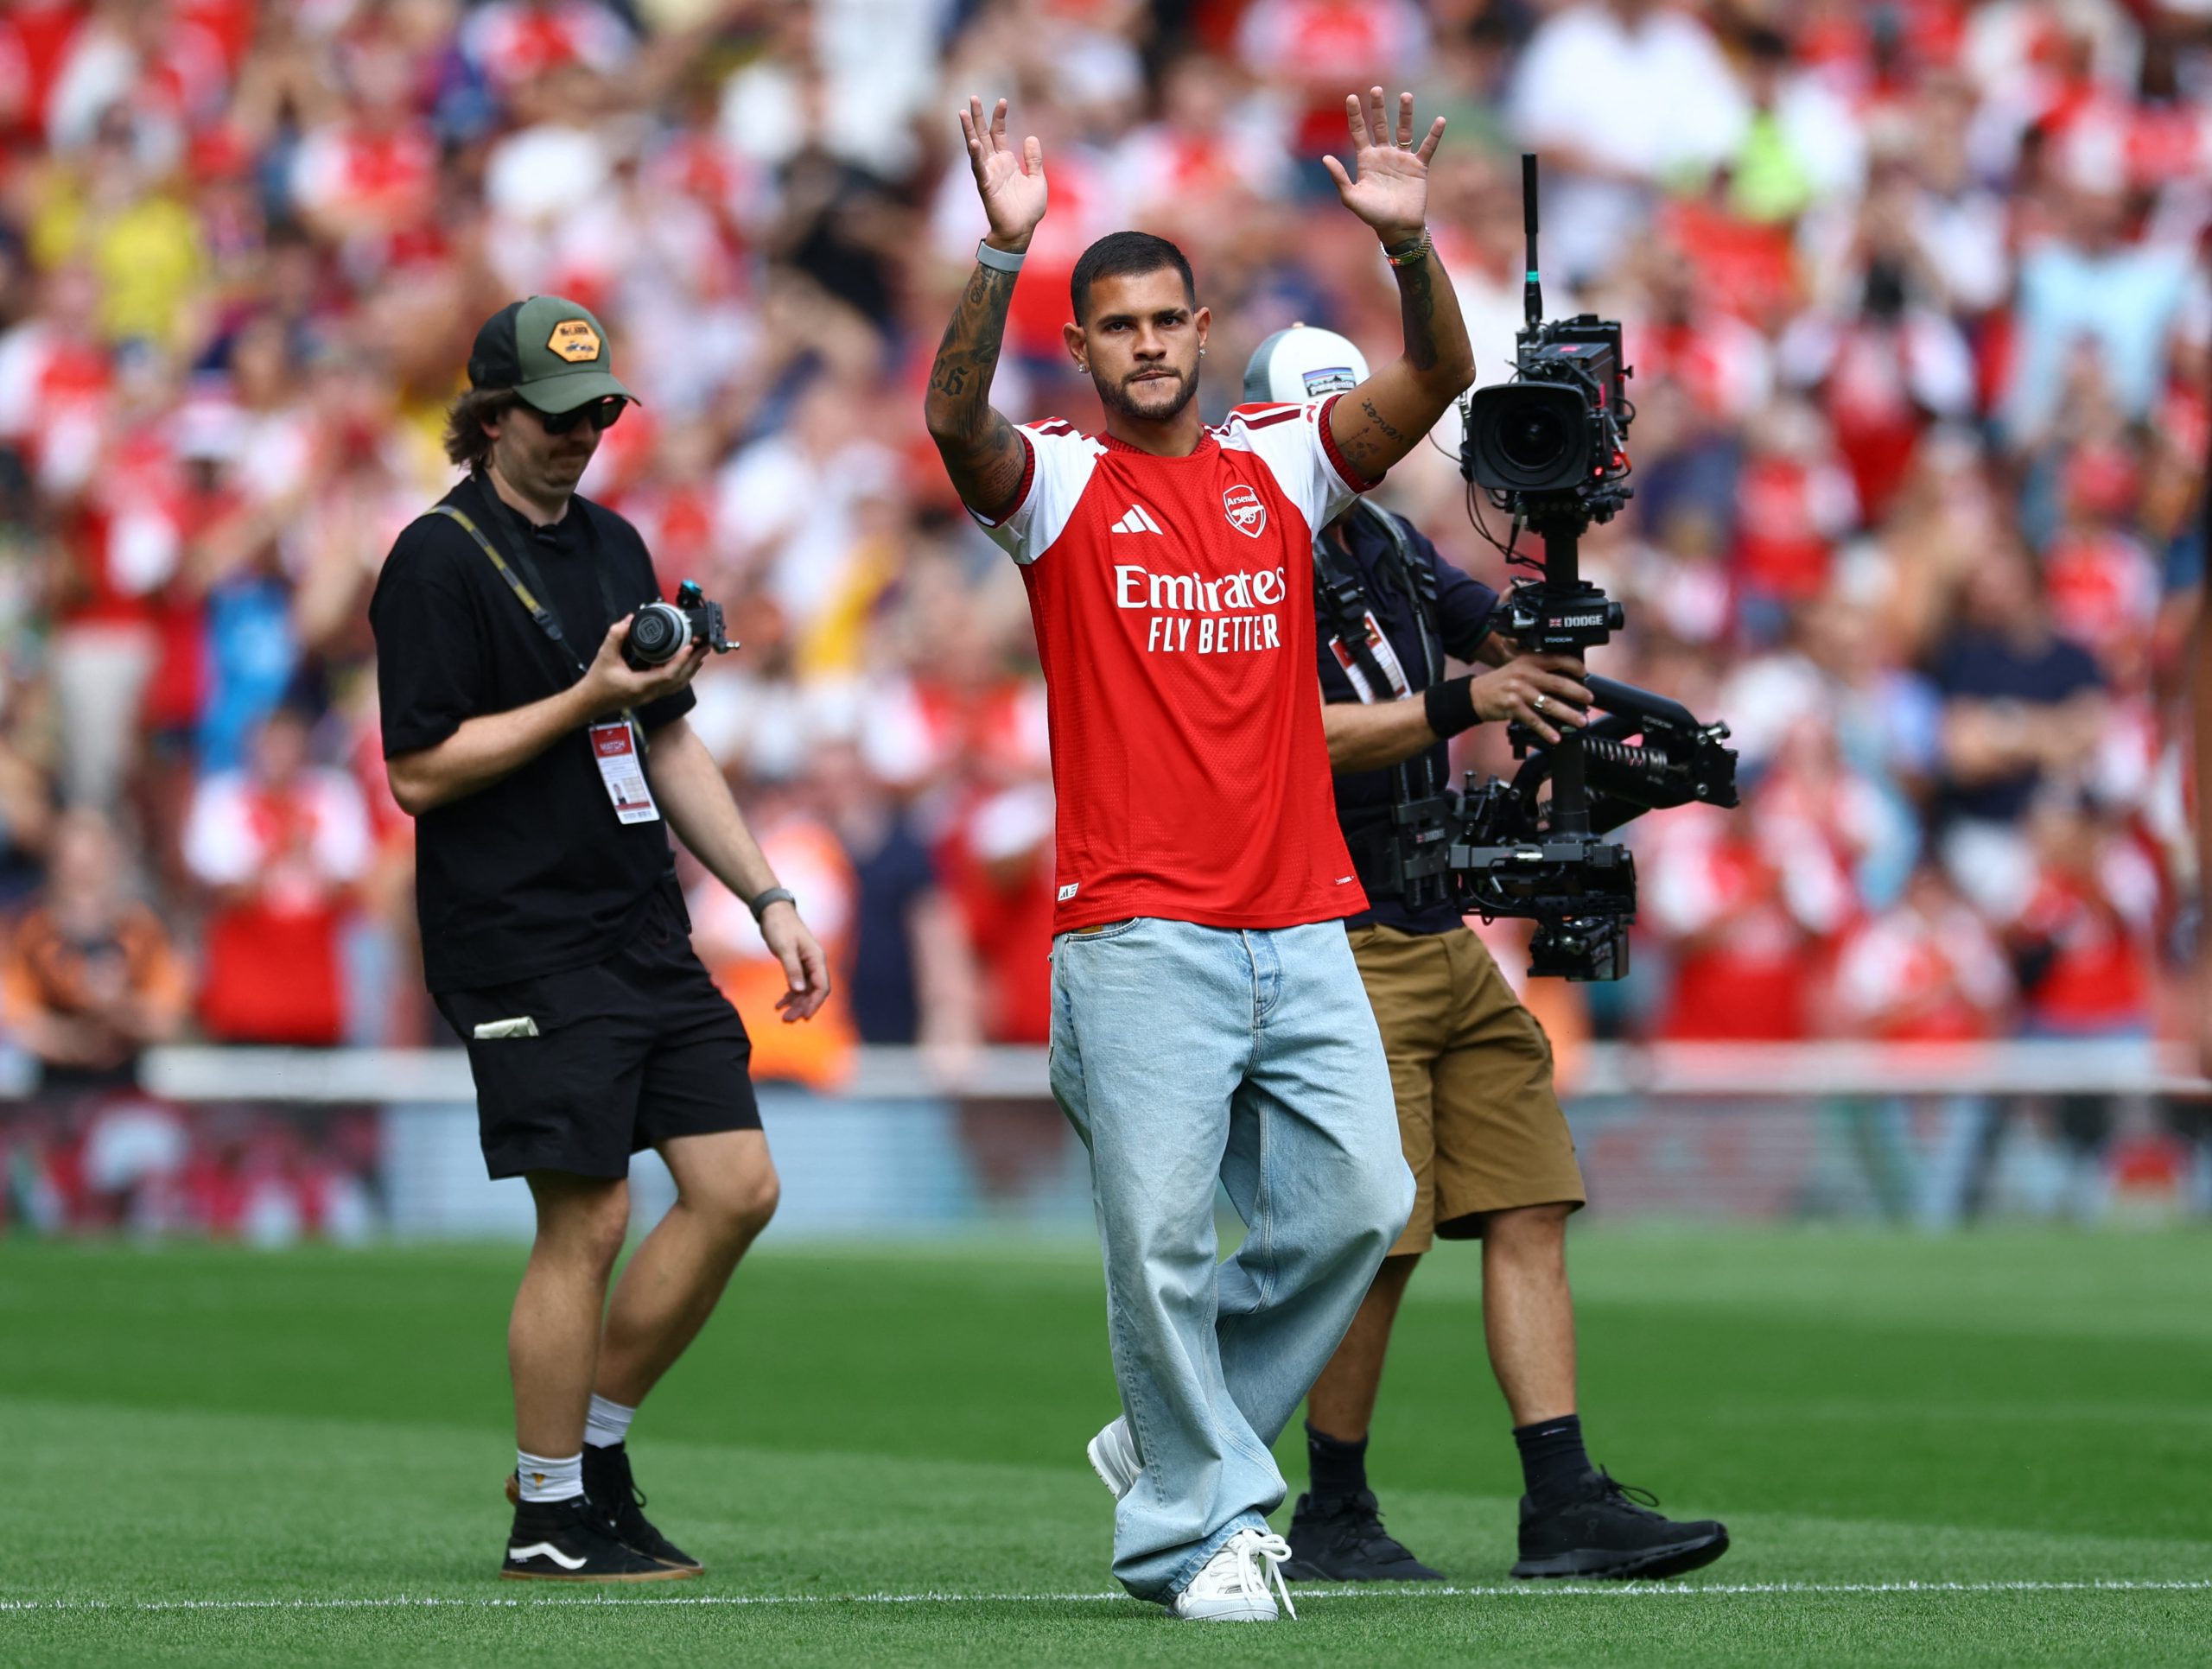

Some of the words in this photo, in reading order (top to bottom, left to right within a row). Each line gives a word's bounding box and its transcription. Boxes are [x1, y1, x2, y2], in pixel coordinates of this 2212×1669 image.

[1227, 494, 1257, 506] Arsenal
[1114, 565, 1286, 612] Emirates
[1147, 617, 1192, 652] FLY
[1198, 613, 1281, 654] BETTER
[1564, 614, 1604, 628] DODGE
